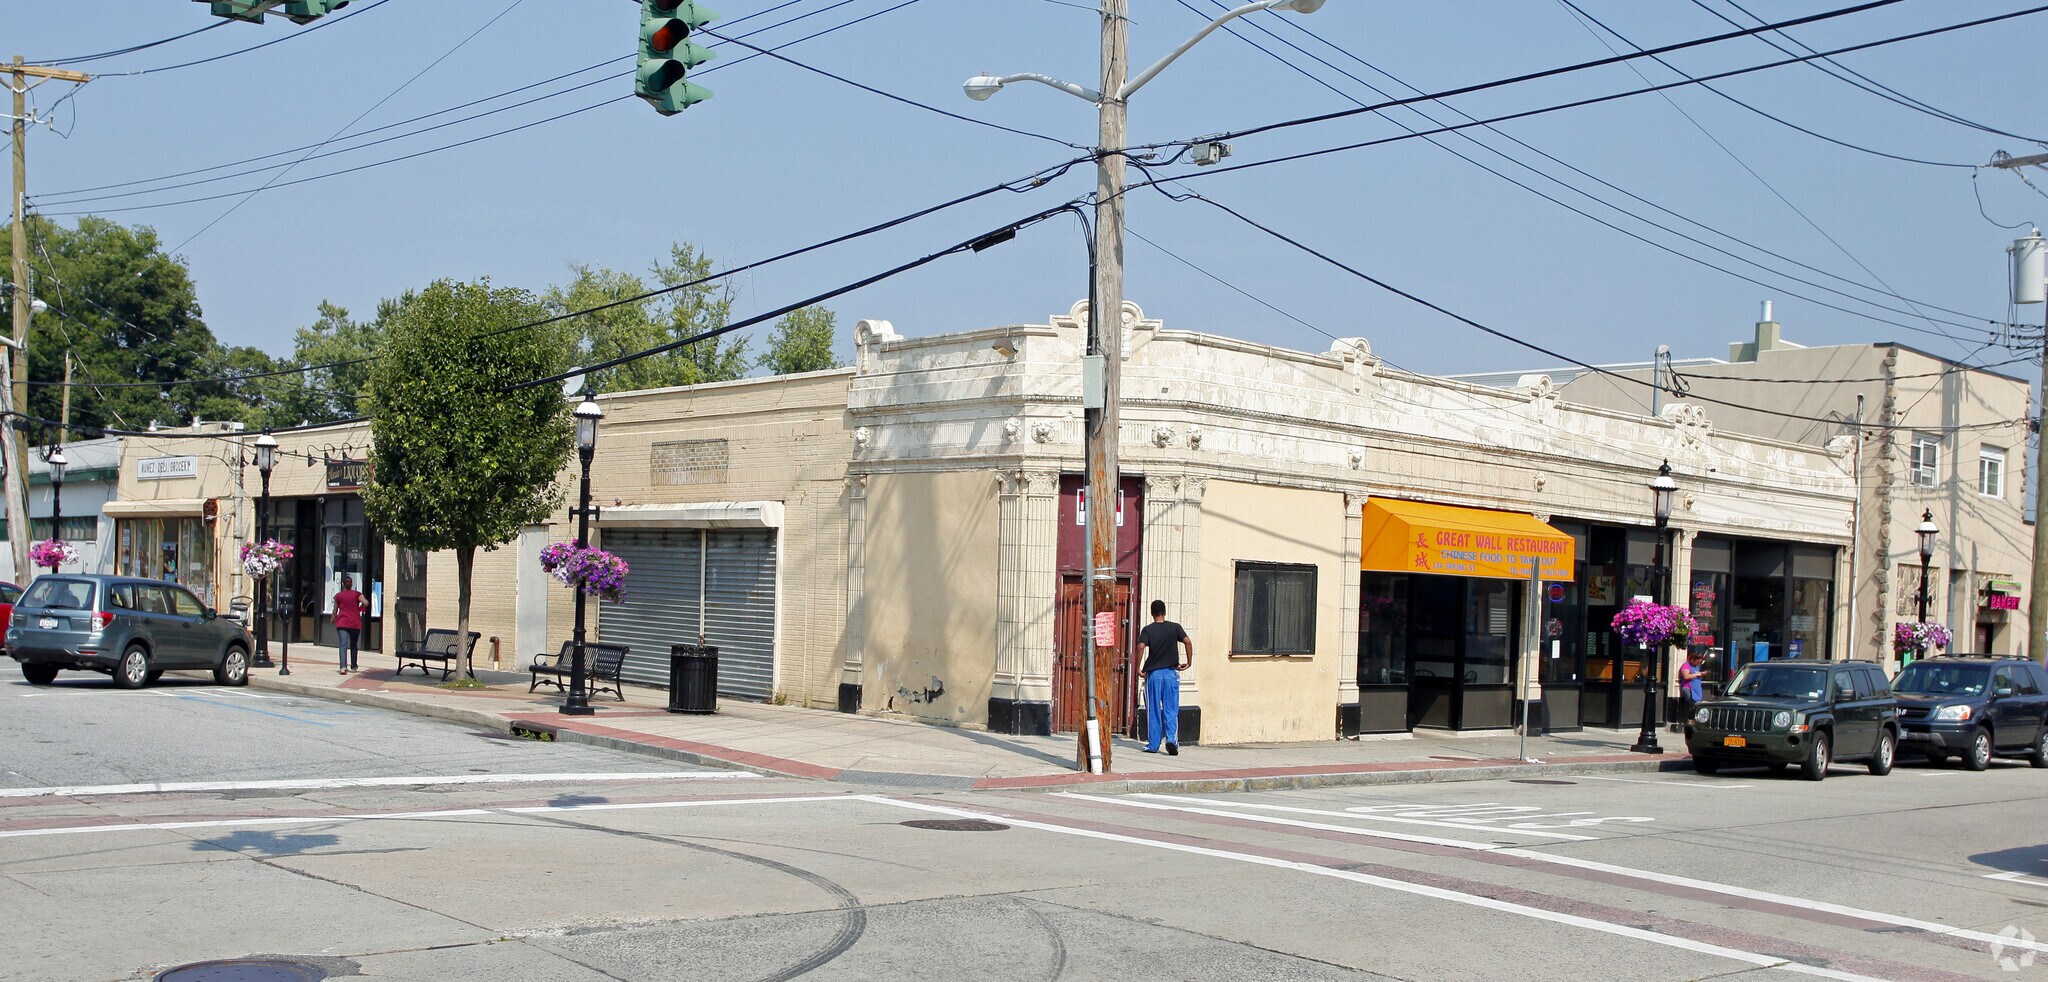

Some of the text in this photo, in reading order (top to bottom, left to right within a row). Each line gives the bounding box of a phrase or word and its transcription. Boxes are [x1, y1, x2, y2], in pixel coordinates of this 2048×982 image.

[1436, 530, 1569, 555] GREAT WALL RESTAURANT
[1441, 549, 1477, 561] CHINESE
[1480, 552, 1503, 563] FOOD
[1506, 554, 1517, 564] TO
[1541, 557, 1557, 566] OUT
[1445, 563, 1467, 571] SPRING
[1990, 594, 2020, 610] BAKERY
